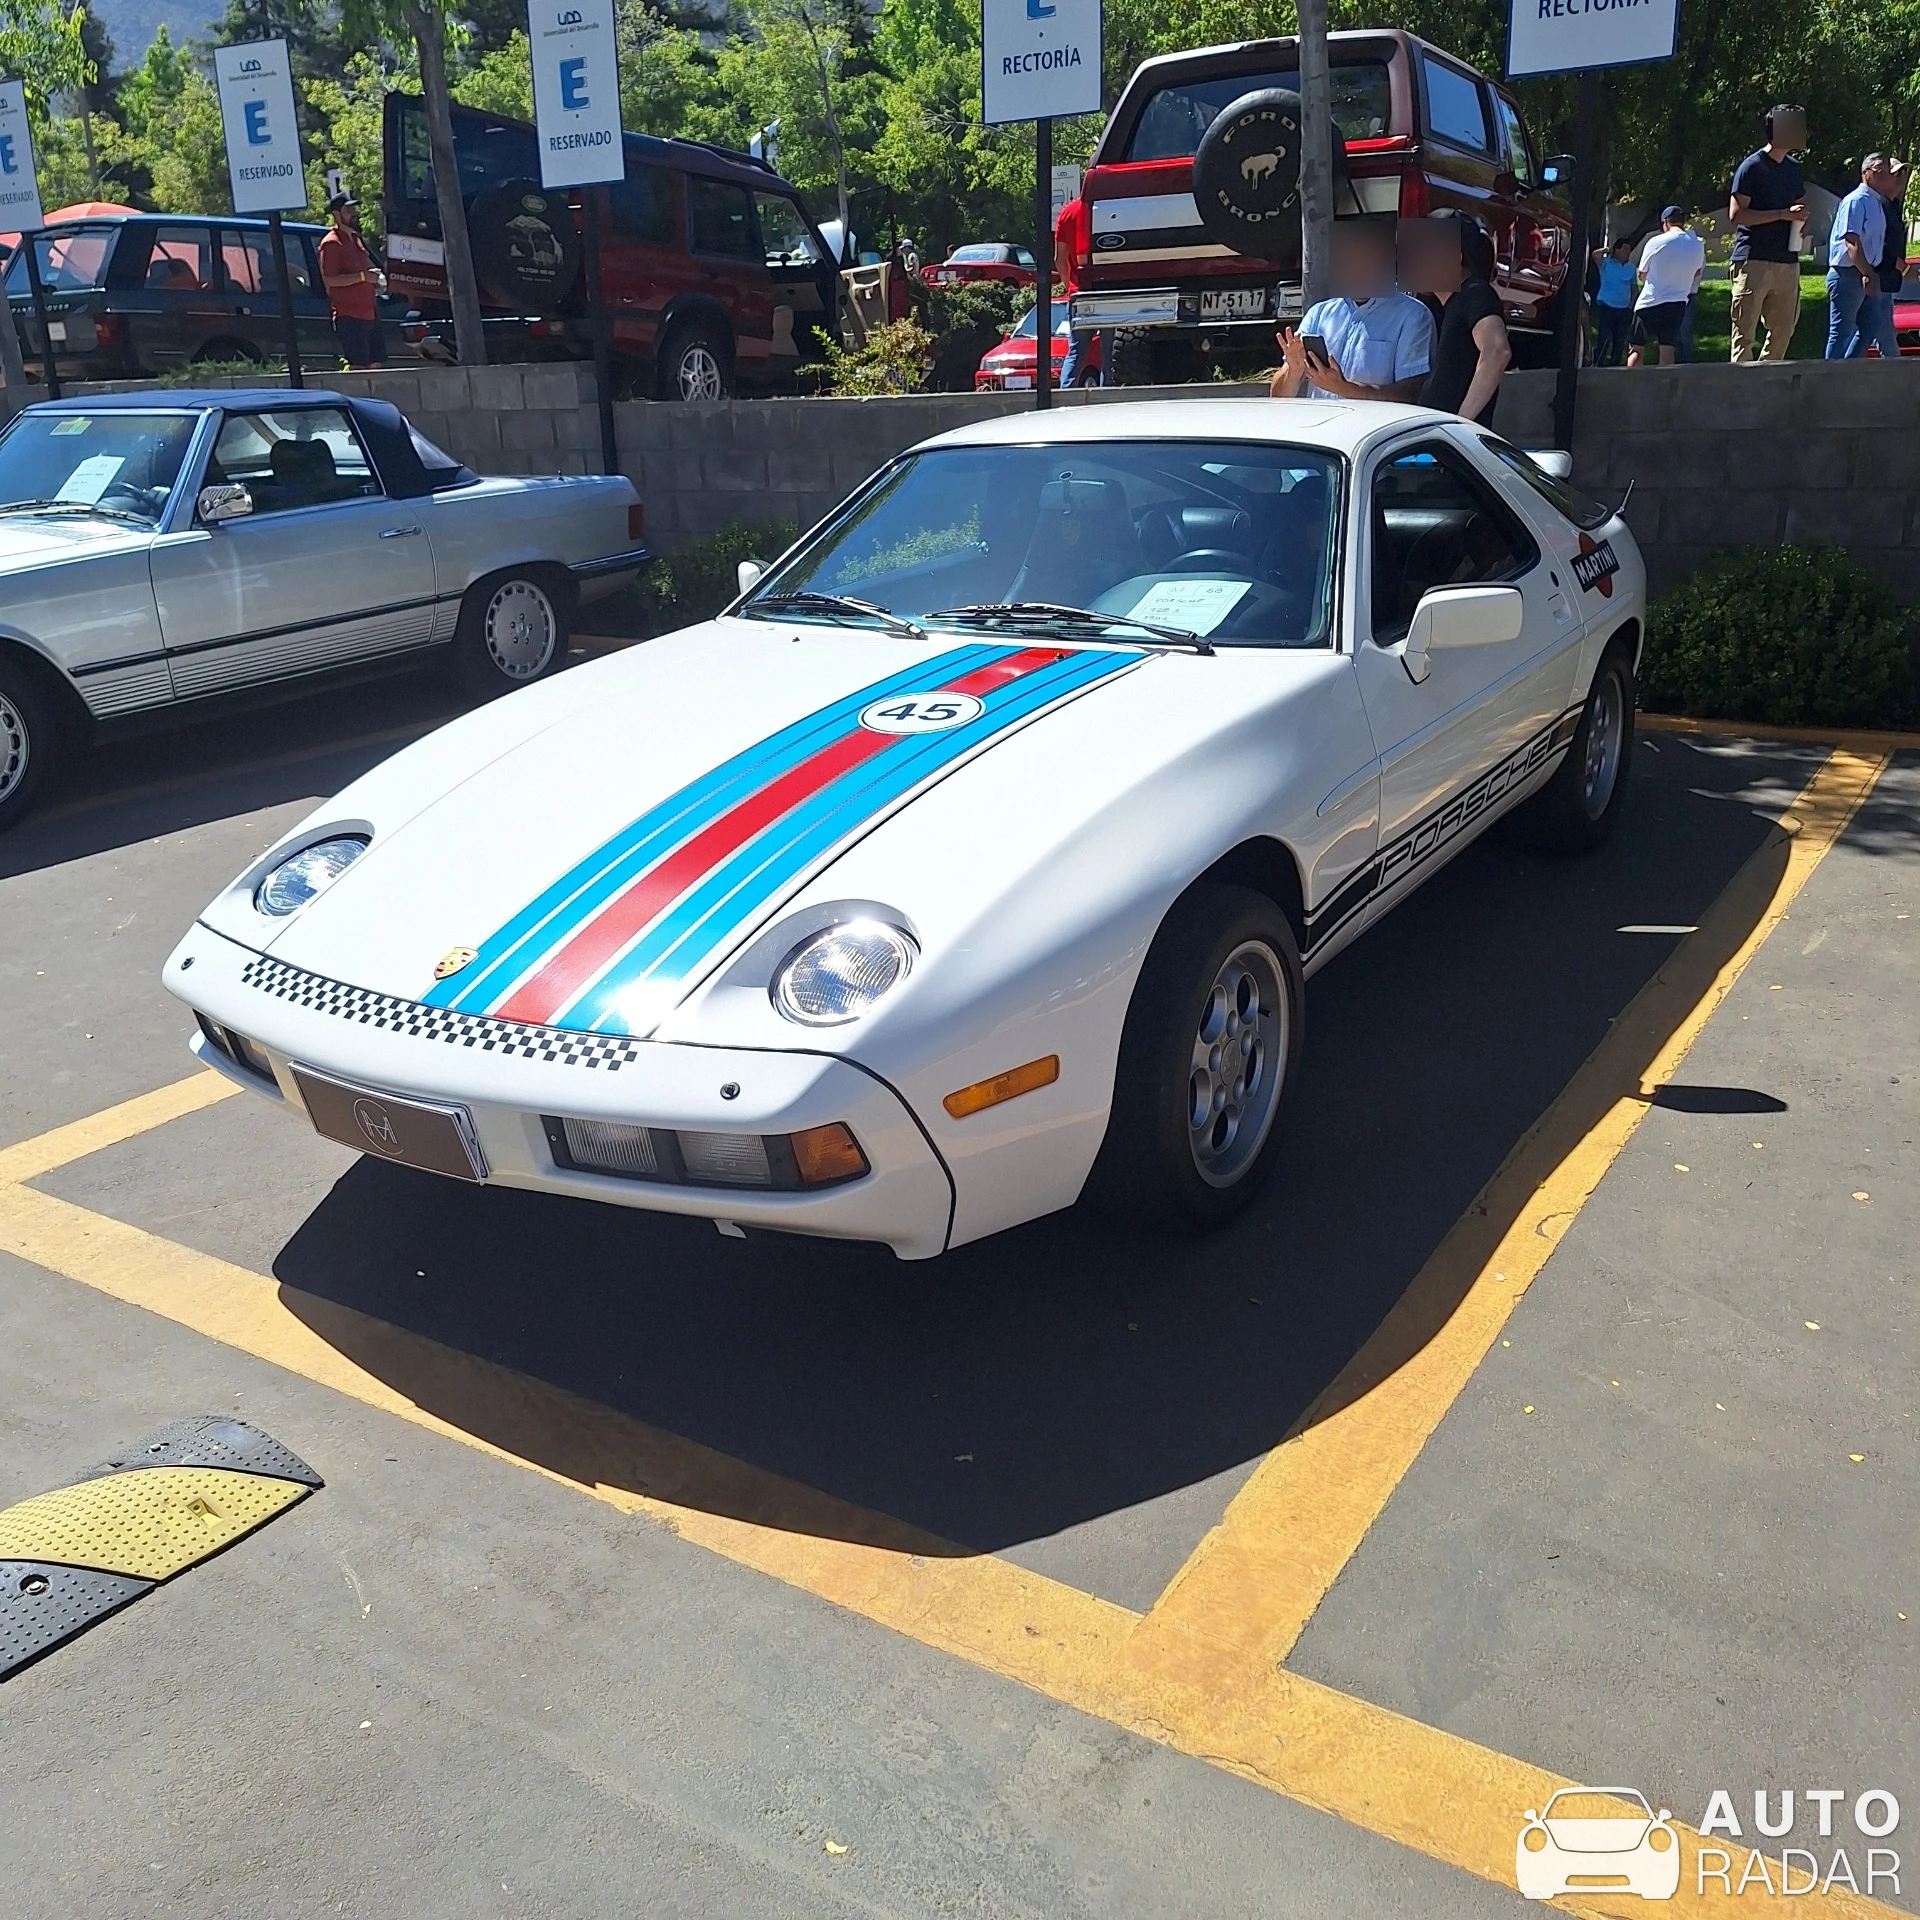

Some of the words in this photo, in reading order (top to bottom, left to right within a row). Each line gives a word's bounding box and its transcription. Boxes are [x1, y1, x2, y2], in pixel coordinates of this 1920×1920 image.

[1538, 0, 1650, 19] RECTO
[1002, 44, 1081, 75] RECTORÍA
[559, 57, 590, 111] E
[243, 100, 273, 146] E
[1223, 111, 1296, 144] FORD
[549, 130, 612, 151] RESERVADO
[239, 163, 294, 181] RESERVADO
[0, 190, 34, 205] ESERVADO
[389, 272, 443, 287] DISCOVERY
[1575, 545, 1617, 585] MARTINI
[876, 702, 963, 721] 45
[1376, 734, 1552, 888] PORSCHE
